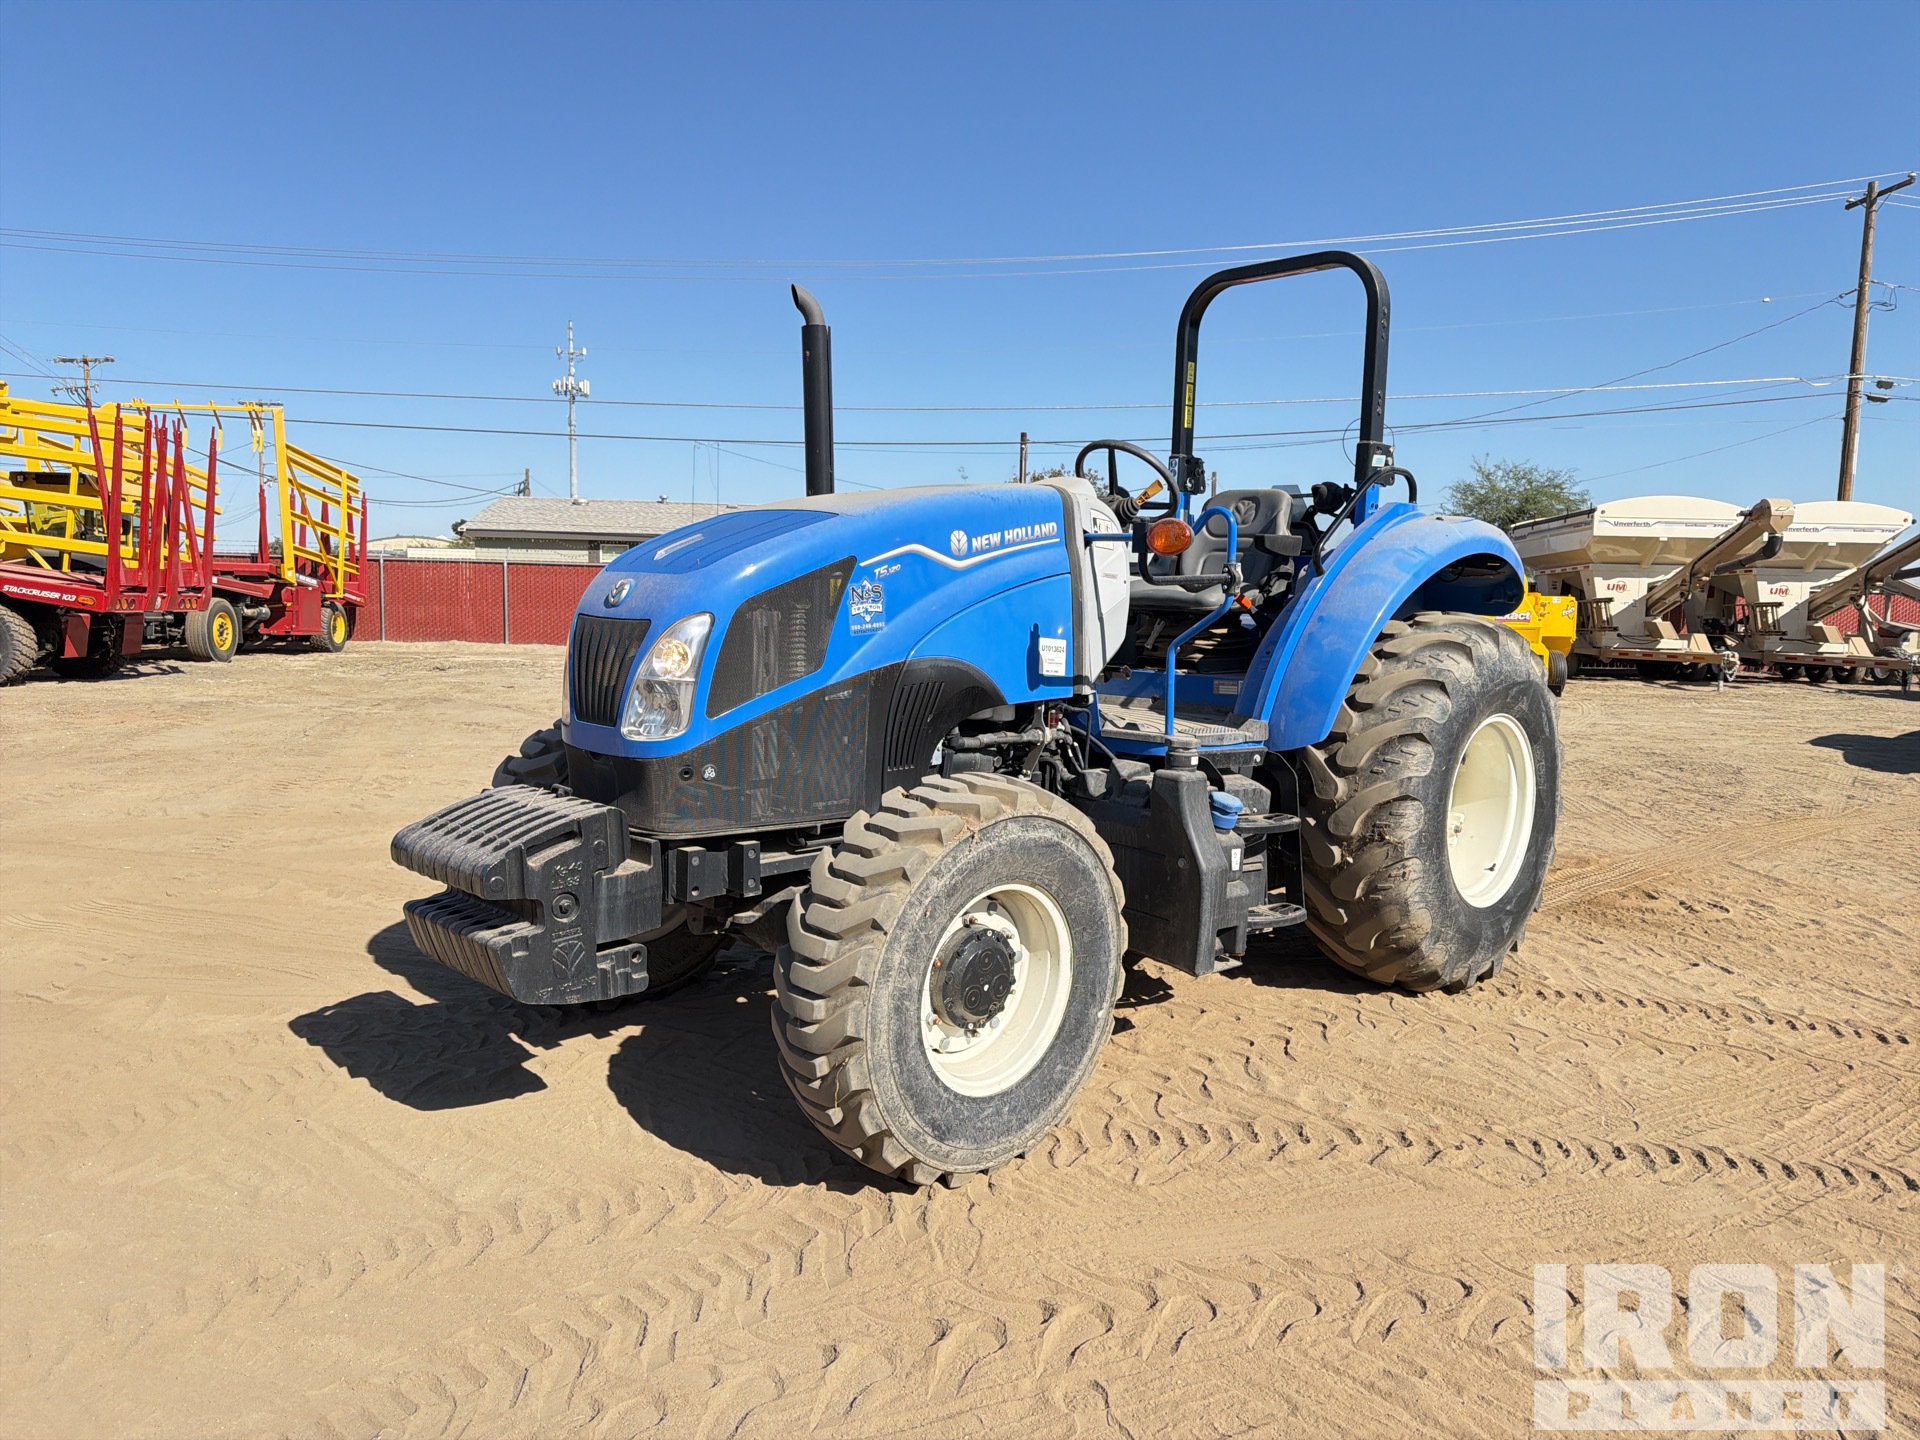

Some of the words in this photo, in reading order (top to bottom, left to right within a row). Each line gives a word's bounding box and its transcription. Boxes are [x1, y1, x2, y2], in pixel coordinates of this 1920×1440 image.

[971, 532, 1001, 552] NEW
[1004, 521, 1058, 545] HOLLAND
[2, 585, 60, 600] STACKCRUISER
[61, 594, 77, 602] 103
